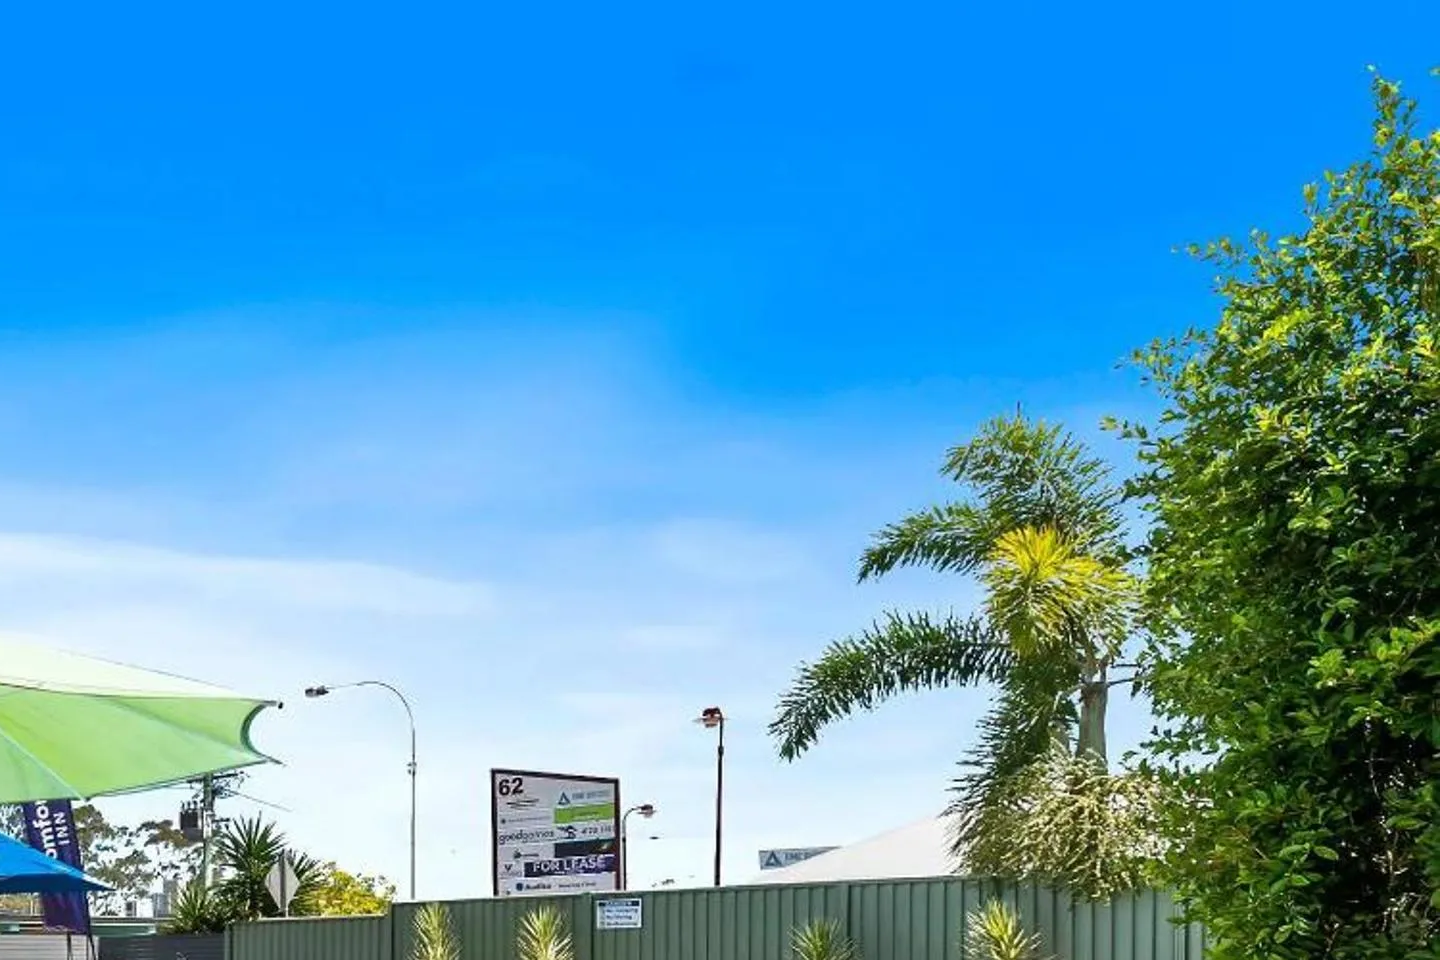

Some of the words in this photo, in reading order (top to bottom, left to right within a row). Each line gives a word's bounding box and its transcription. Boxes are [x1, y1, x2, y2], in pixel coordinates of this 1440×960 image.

[498, 777, 524, 797] 62
[52, 811, 71, 846] INN
[532, 859, 560, 872] FOR
[563, 855, 607, 871] LEASE
